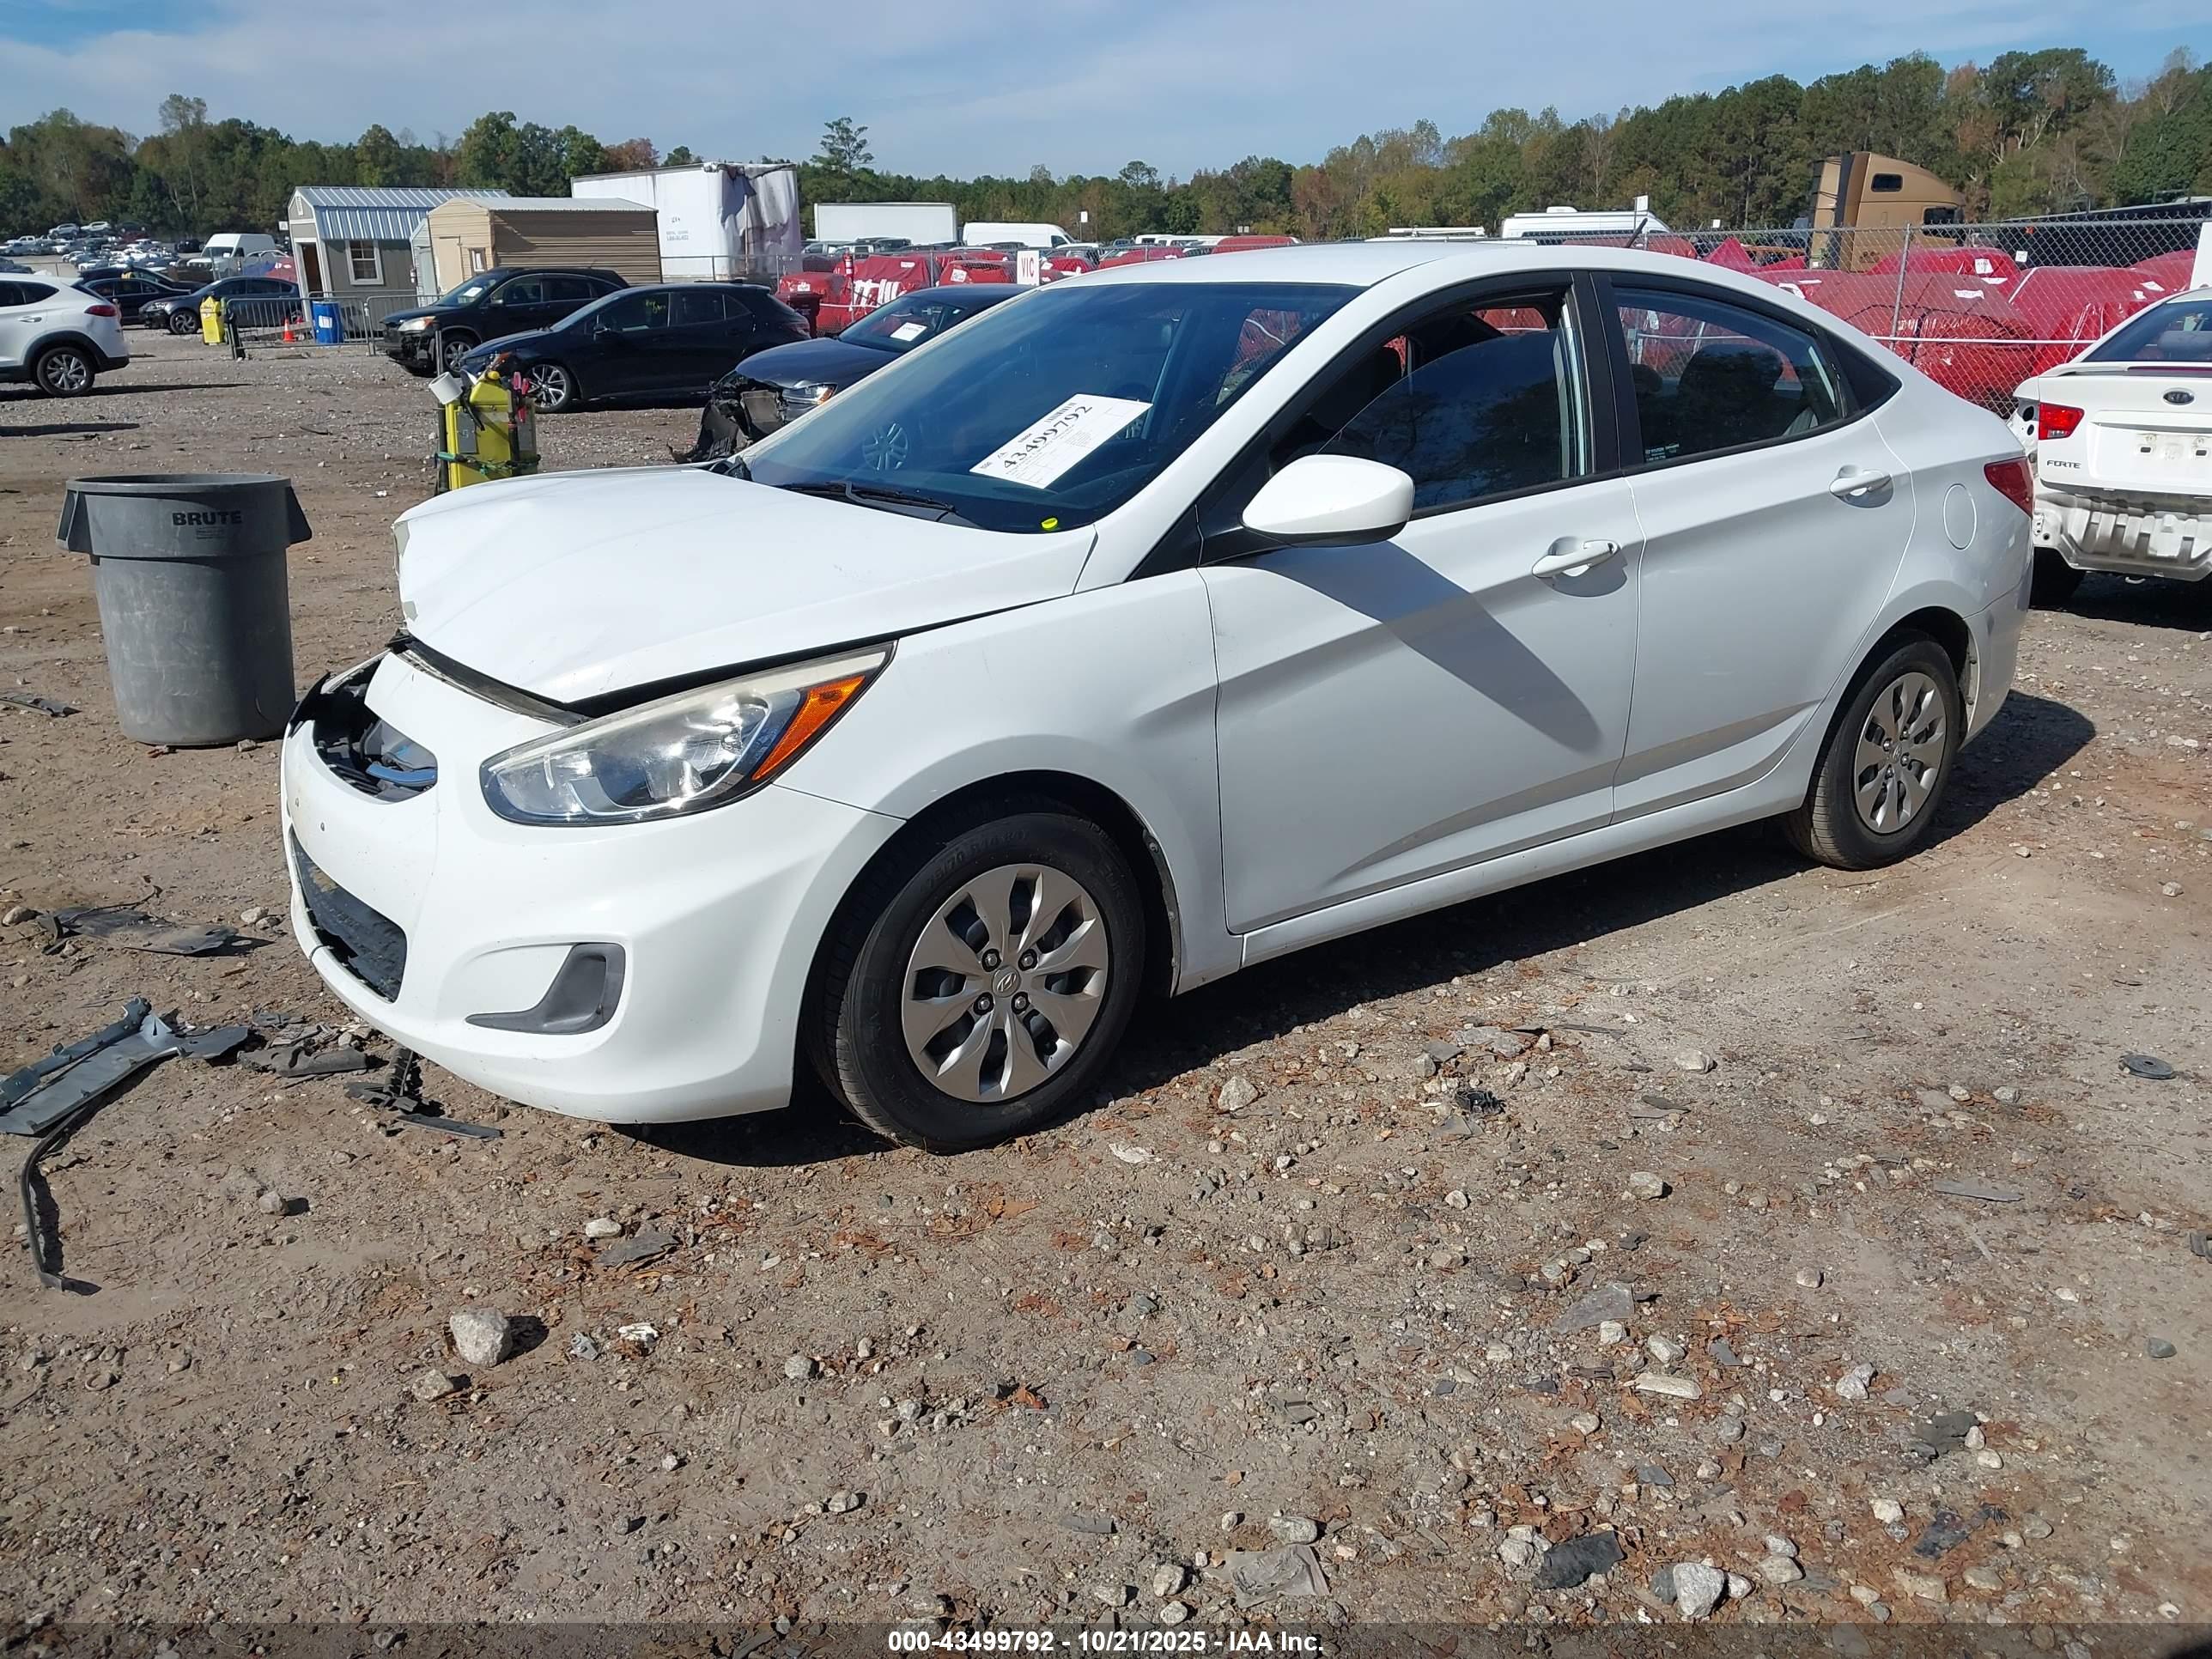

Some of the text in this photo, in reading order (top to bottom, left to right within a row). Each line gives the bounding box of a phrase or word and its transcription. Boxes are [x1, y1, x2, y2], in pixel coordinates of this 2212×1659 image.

[1021, 257, 1035, 277] VIC
[1003, 405, 1093, 469] 43499792
[2046, 459, 2082, 470] FORTE
[172, 511, 242, 526] BRUTE
